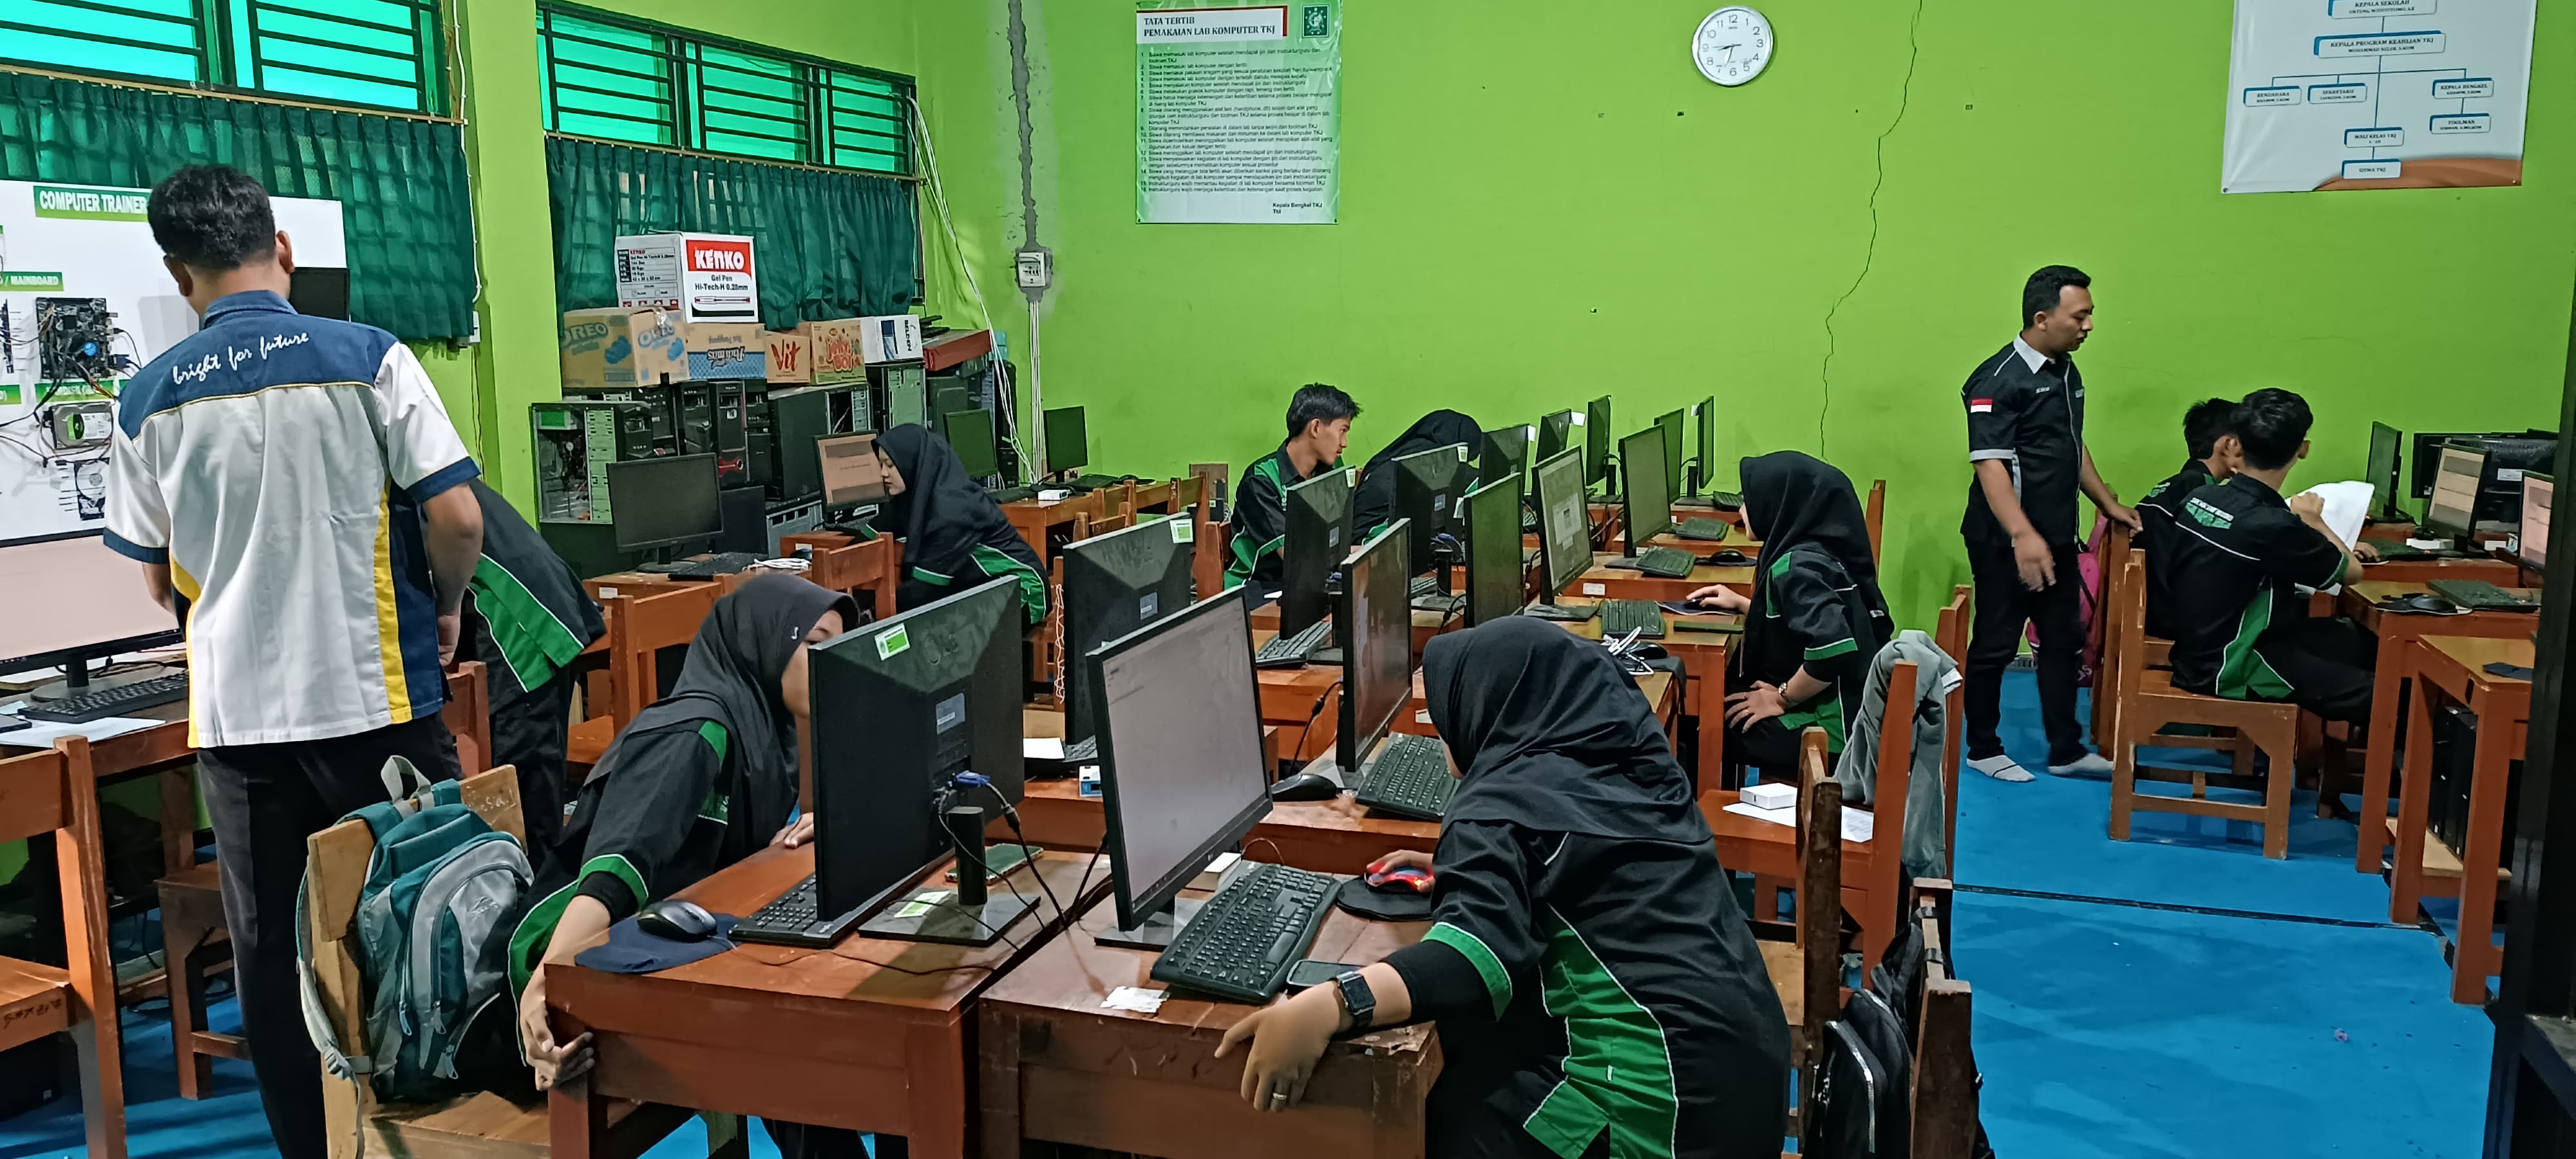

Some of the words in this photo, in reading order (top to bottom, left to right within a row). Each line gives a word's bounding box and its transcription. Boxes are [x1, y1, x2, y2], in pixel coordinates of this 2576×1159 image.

[1166, 17, 1195, 25] TERTIB
[1144, 28, 1191, 37] PEMAKAIAN
[1261, 25, 1274, 34] TKJ
[1753, 26, 1759, 35] 2
[1730, 68, 1736, 76] 6
[1743, 63, 1750, 71] 5
[39, 191, 100, 211] COMPUTER
[101, 194, 147, 213] TRAINER
[695, 247, 744, 270] KENKO
[11, 276, 59, 286] MAINBOARD
[173, 354, 221, 384] bright
[229, 346, 252, 371] for
[260, 332, 309, 360] future
[771, 339, 800, 372] Vit
